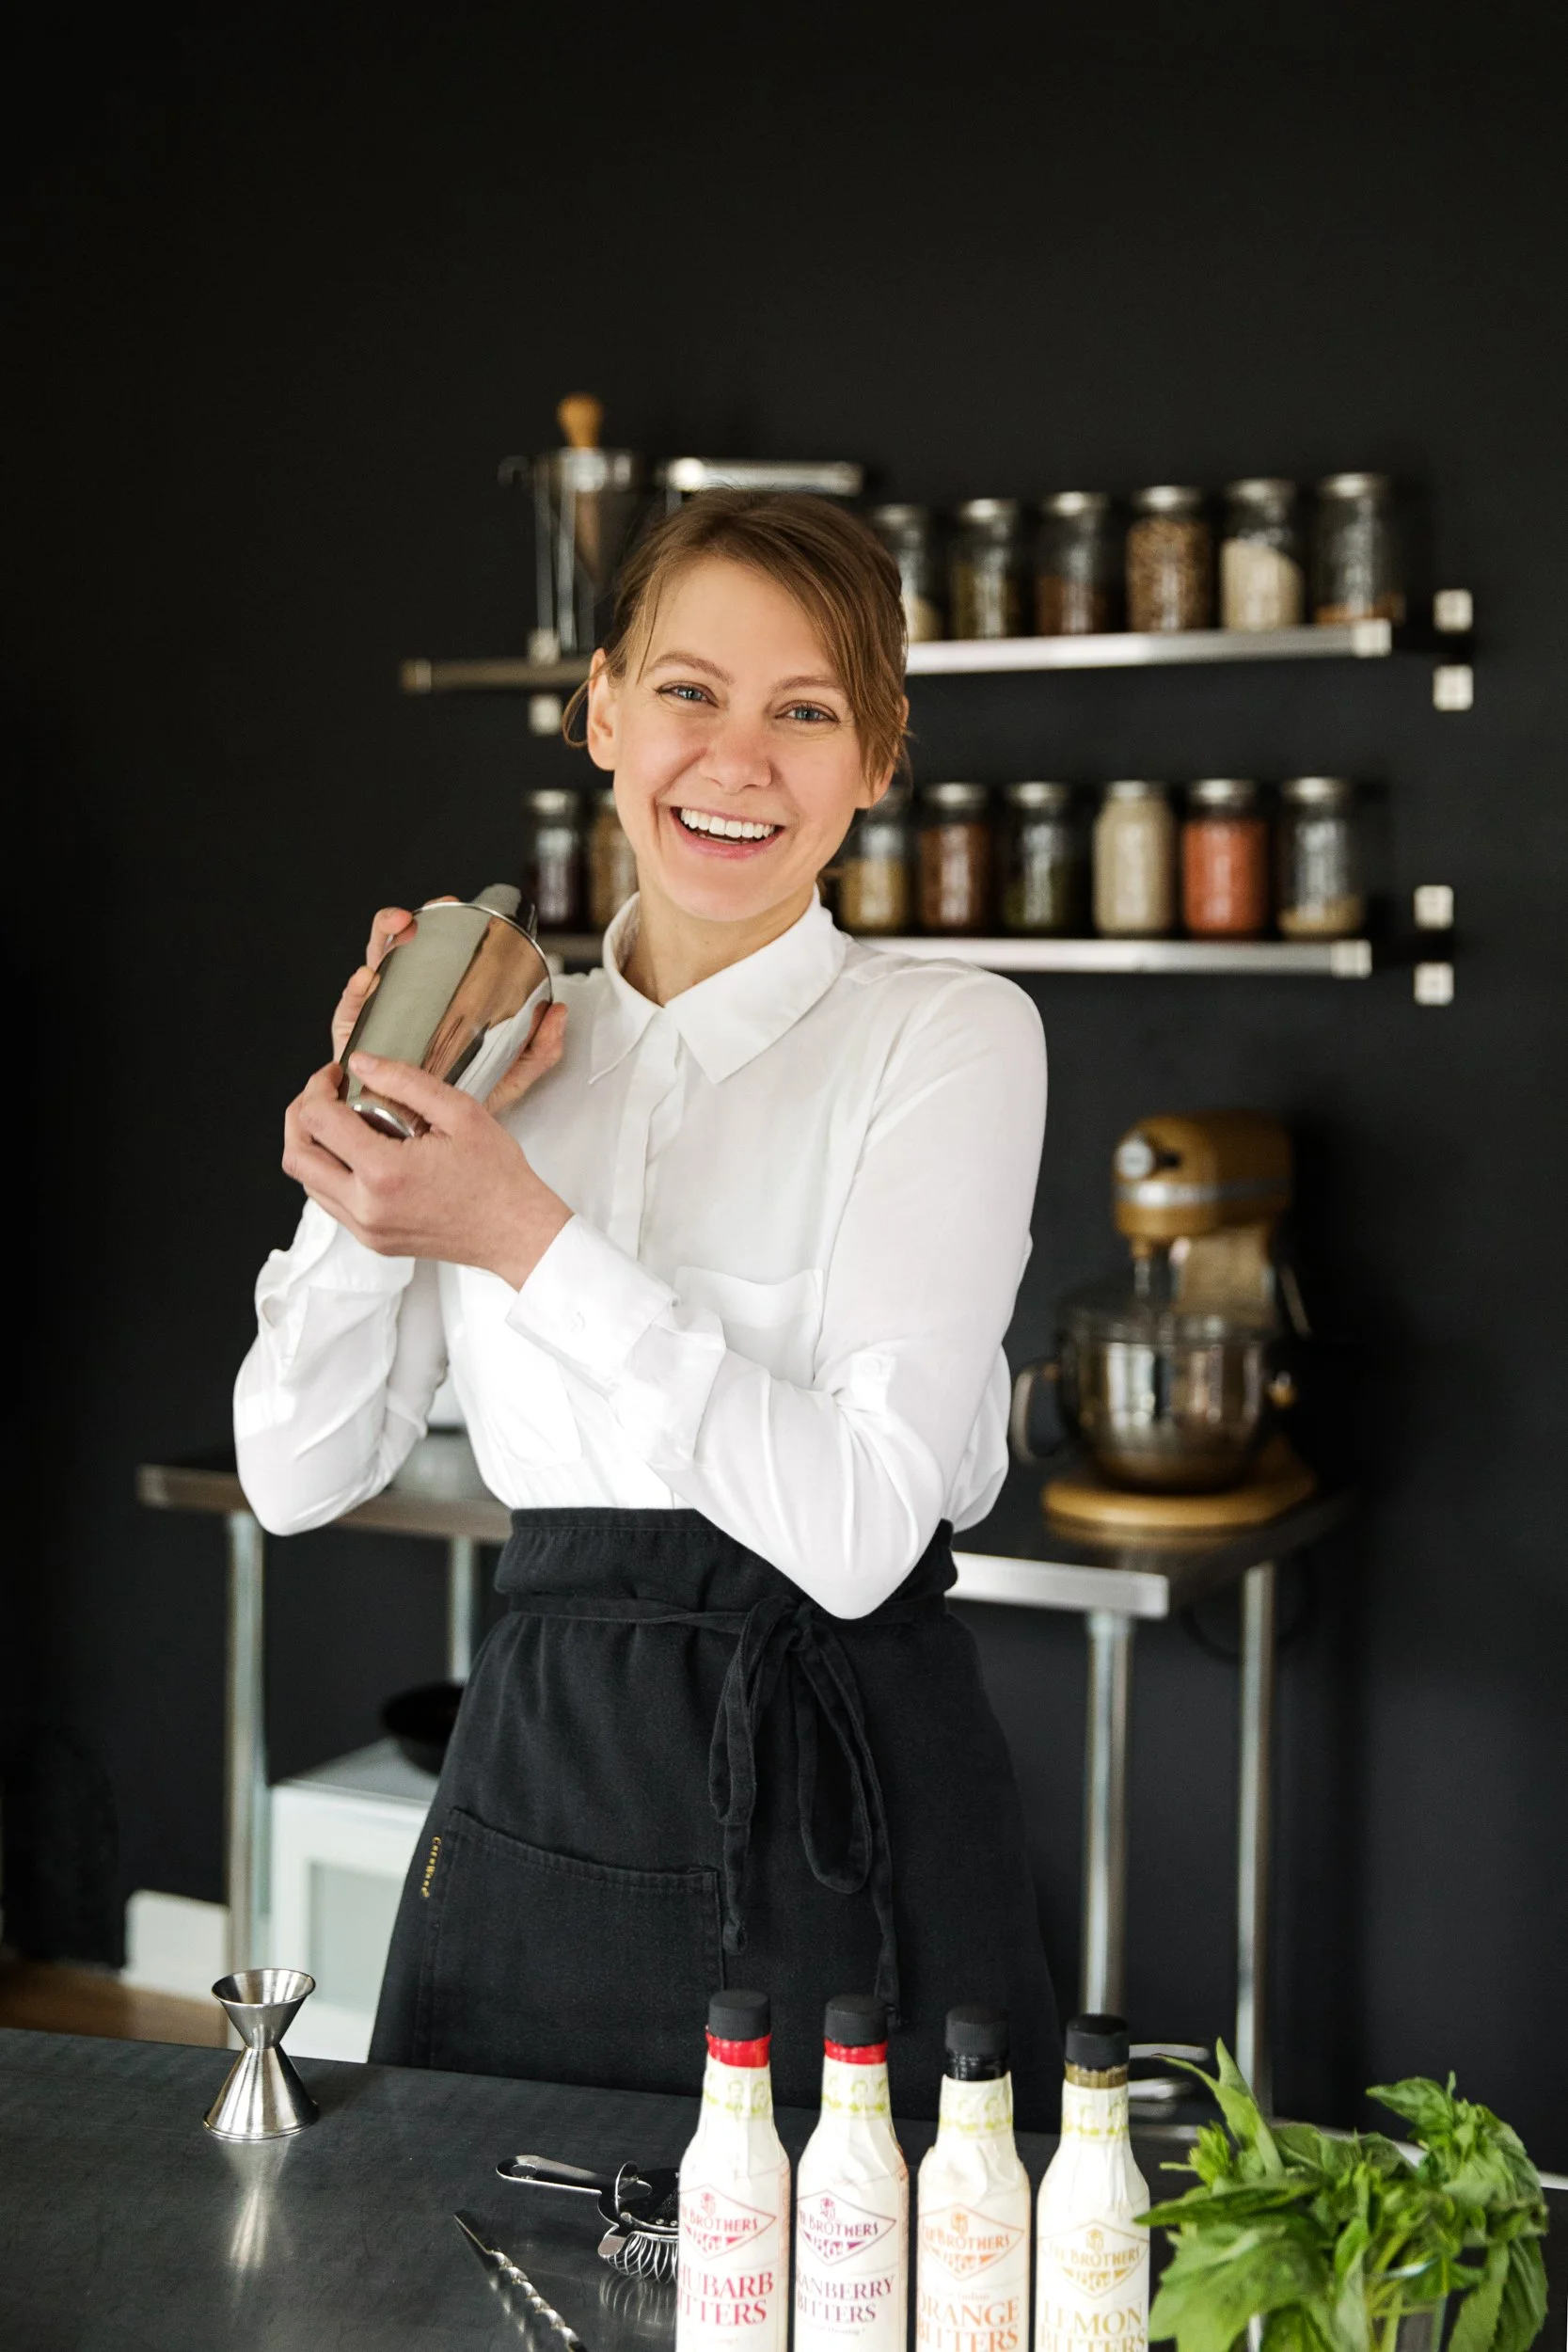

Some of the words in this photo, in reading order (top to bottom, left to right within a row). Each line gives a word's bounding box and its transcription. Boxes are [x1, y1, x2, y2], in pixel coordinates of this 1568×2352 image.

[690, 2209, 758, 2232] BROTHERS
[810, 2214, 879, 2237] BROTHERS
[937, 2228, 1010, 2251] BROTHERS
[1070, 2246, 1140, 2268] BROTHERS
[678, 2263, 774, 2299] HUBARB
[796, 2265, 895, 2300] RANBERRY
[677, 2287, 768, 2327] ITTERS
[1043, 2300, 1142, 2336] LEMON
